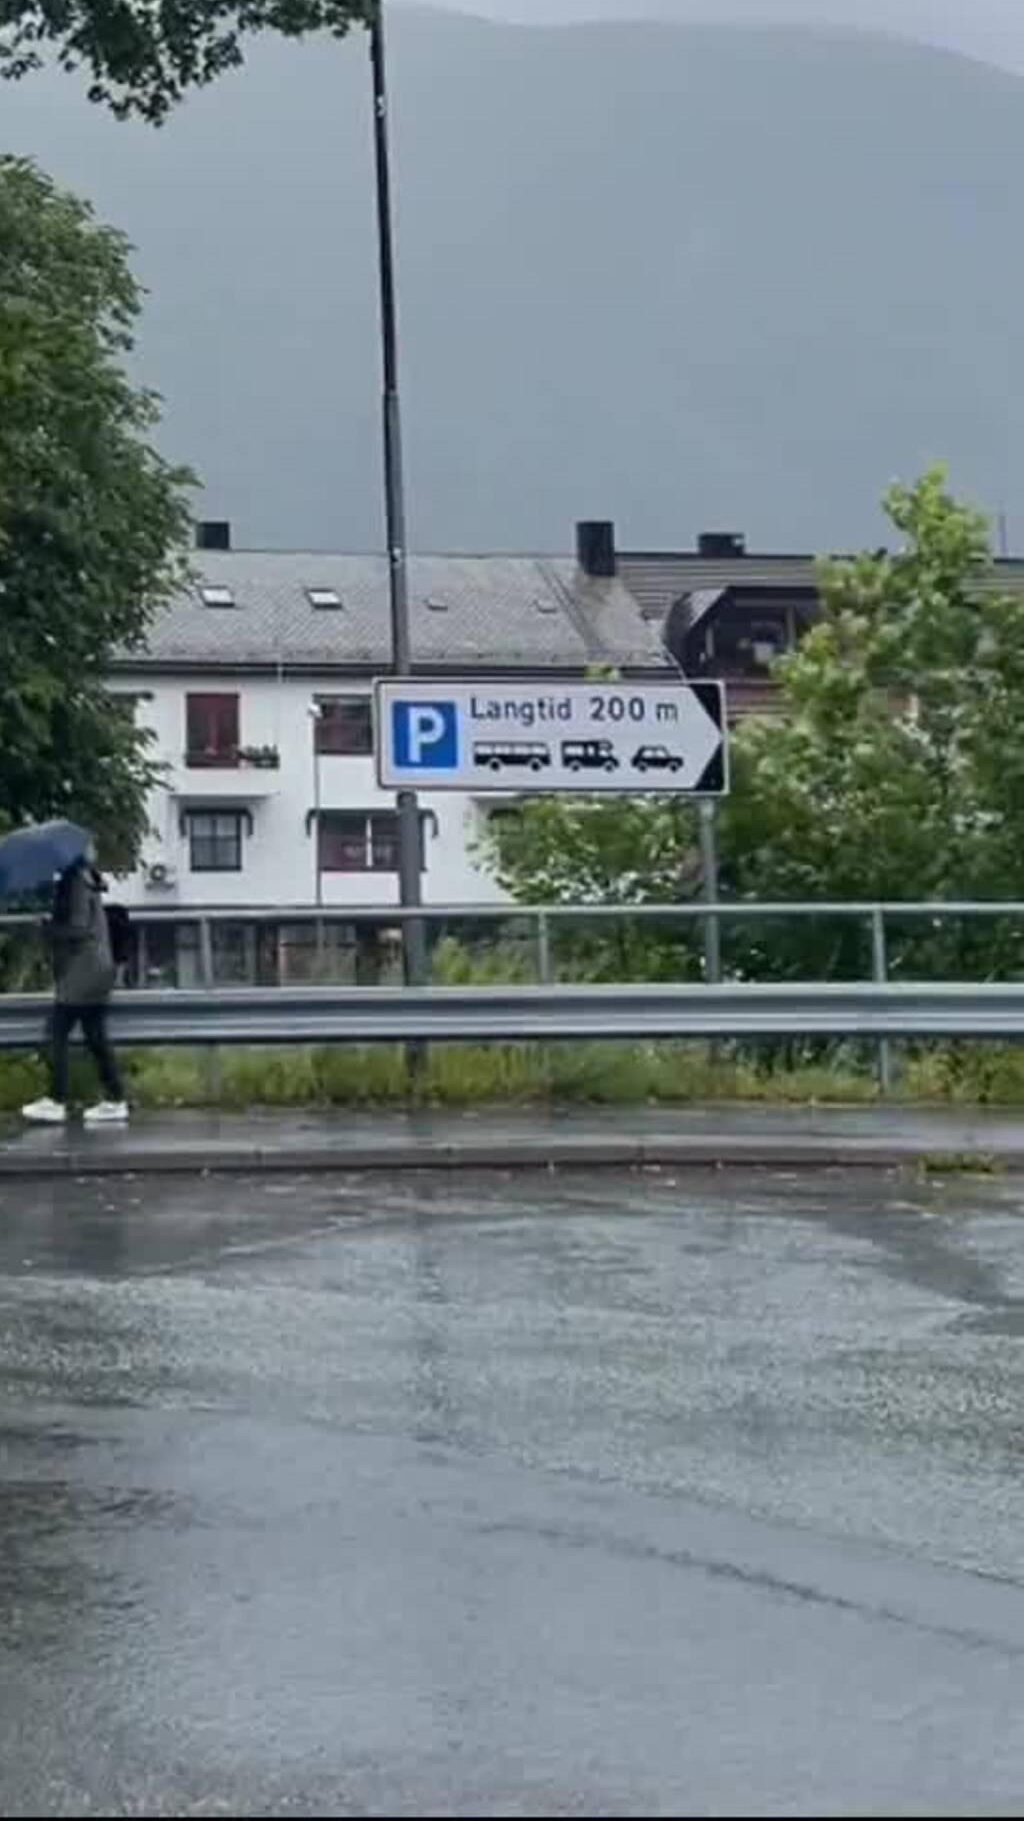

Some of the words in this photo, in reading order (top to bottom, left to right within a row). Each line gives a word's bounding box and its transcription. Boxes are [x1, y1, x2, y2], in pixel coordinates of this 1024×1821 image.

[470, 697, 572, 726] Langtid
[589, 697, 645, 721] 200
[656, 703, 678, 721] m
[407, 707, 445, 763] P
